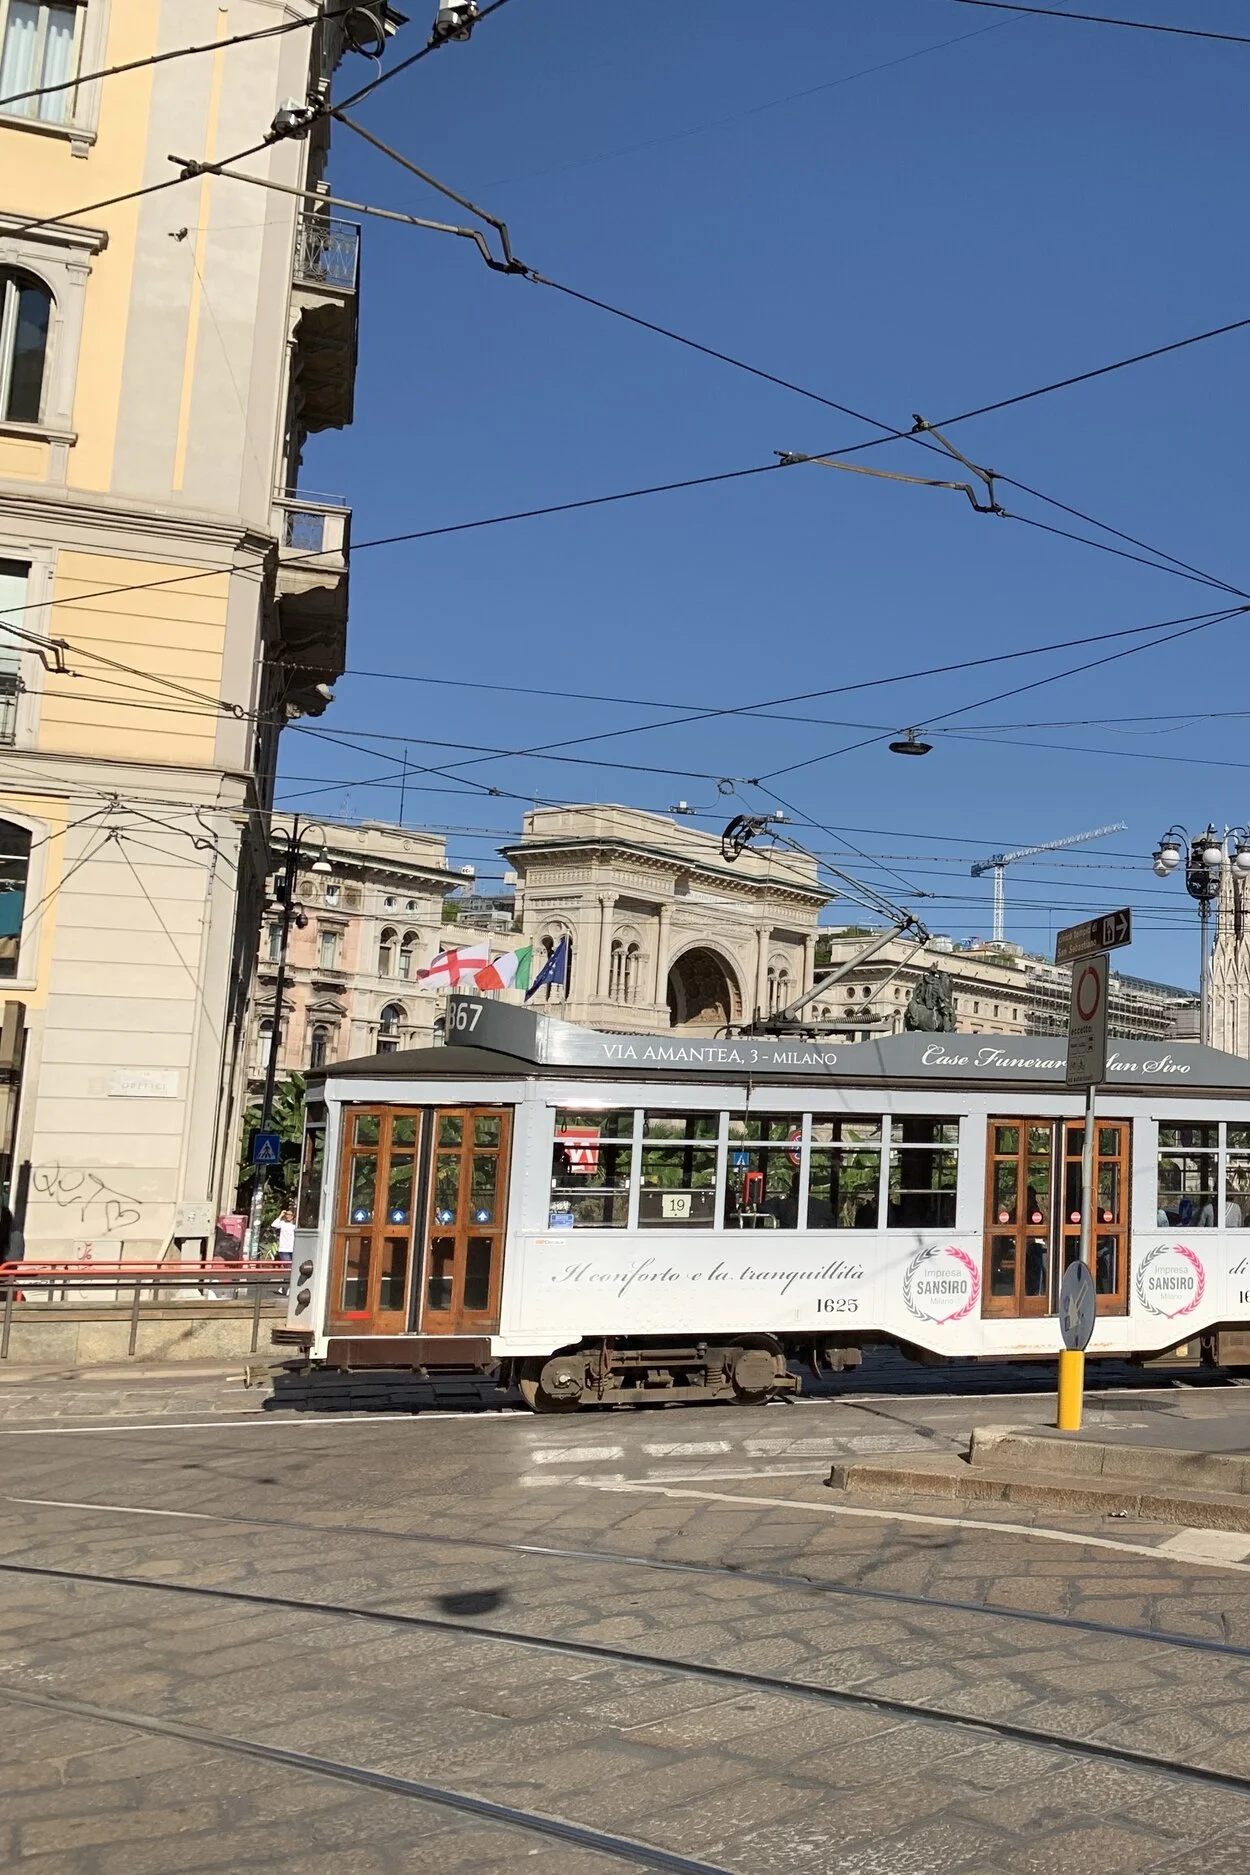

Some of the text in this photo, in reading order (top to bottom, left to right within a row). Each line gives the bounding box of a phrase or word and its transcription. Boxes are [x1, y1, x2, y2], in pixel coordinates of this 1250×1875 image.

[603, 1044, 638, 1060] VIA
[643, 1046, 745, 1065] AMANTEA,
[750, 1049, 759, 1064] 3
[773, 1051, 838, 1066] MILANO
[921, 1043, 969, 1066] Case
[974, 1047, 1067, 1069] Funerar
[1141, 1054, 1192, 1075] Siro
[669, 1198, 686, 1213] 19
[924, 1268, 962, 1278] Impresa
[1154, 1265, 1189, 1275] Impresa
[1228, 1257, 1249, 1276] di
[551, 1257, 865, 1299] Il conforto e la tranquillità
[1148, 1276, 1194, 1291] SANSIRO
[916, 1280, 968, 1295] SANSIRO
[929, 1297, 955, 1305] Milano
[1160, 1293, 1183, 1301] Milano
[816, 1298, 859, 1314] 1625
